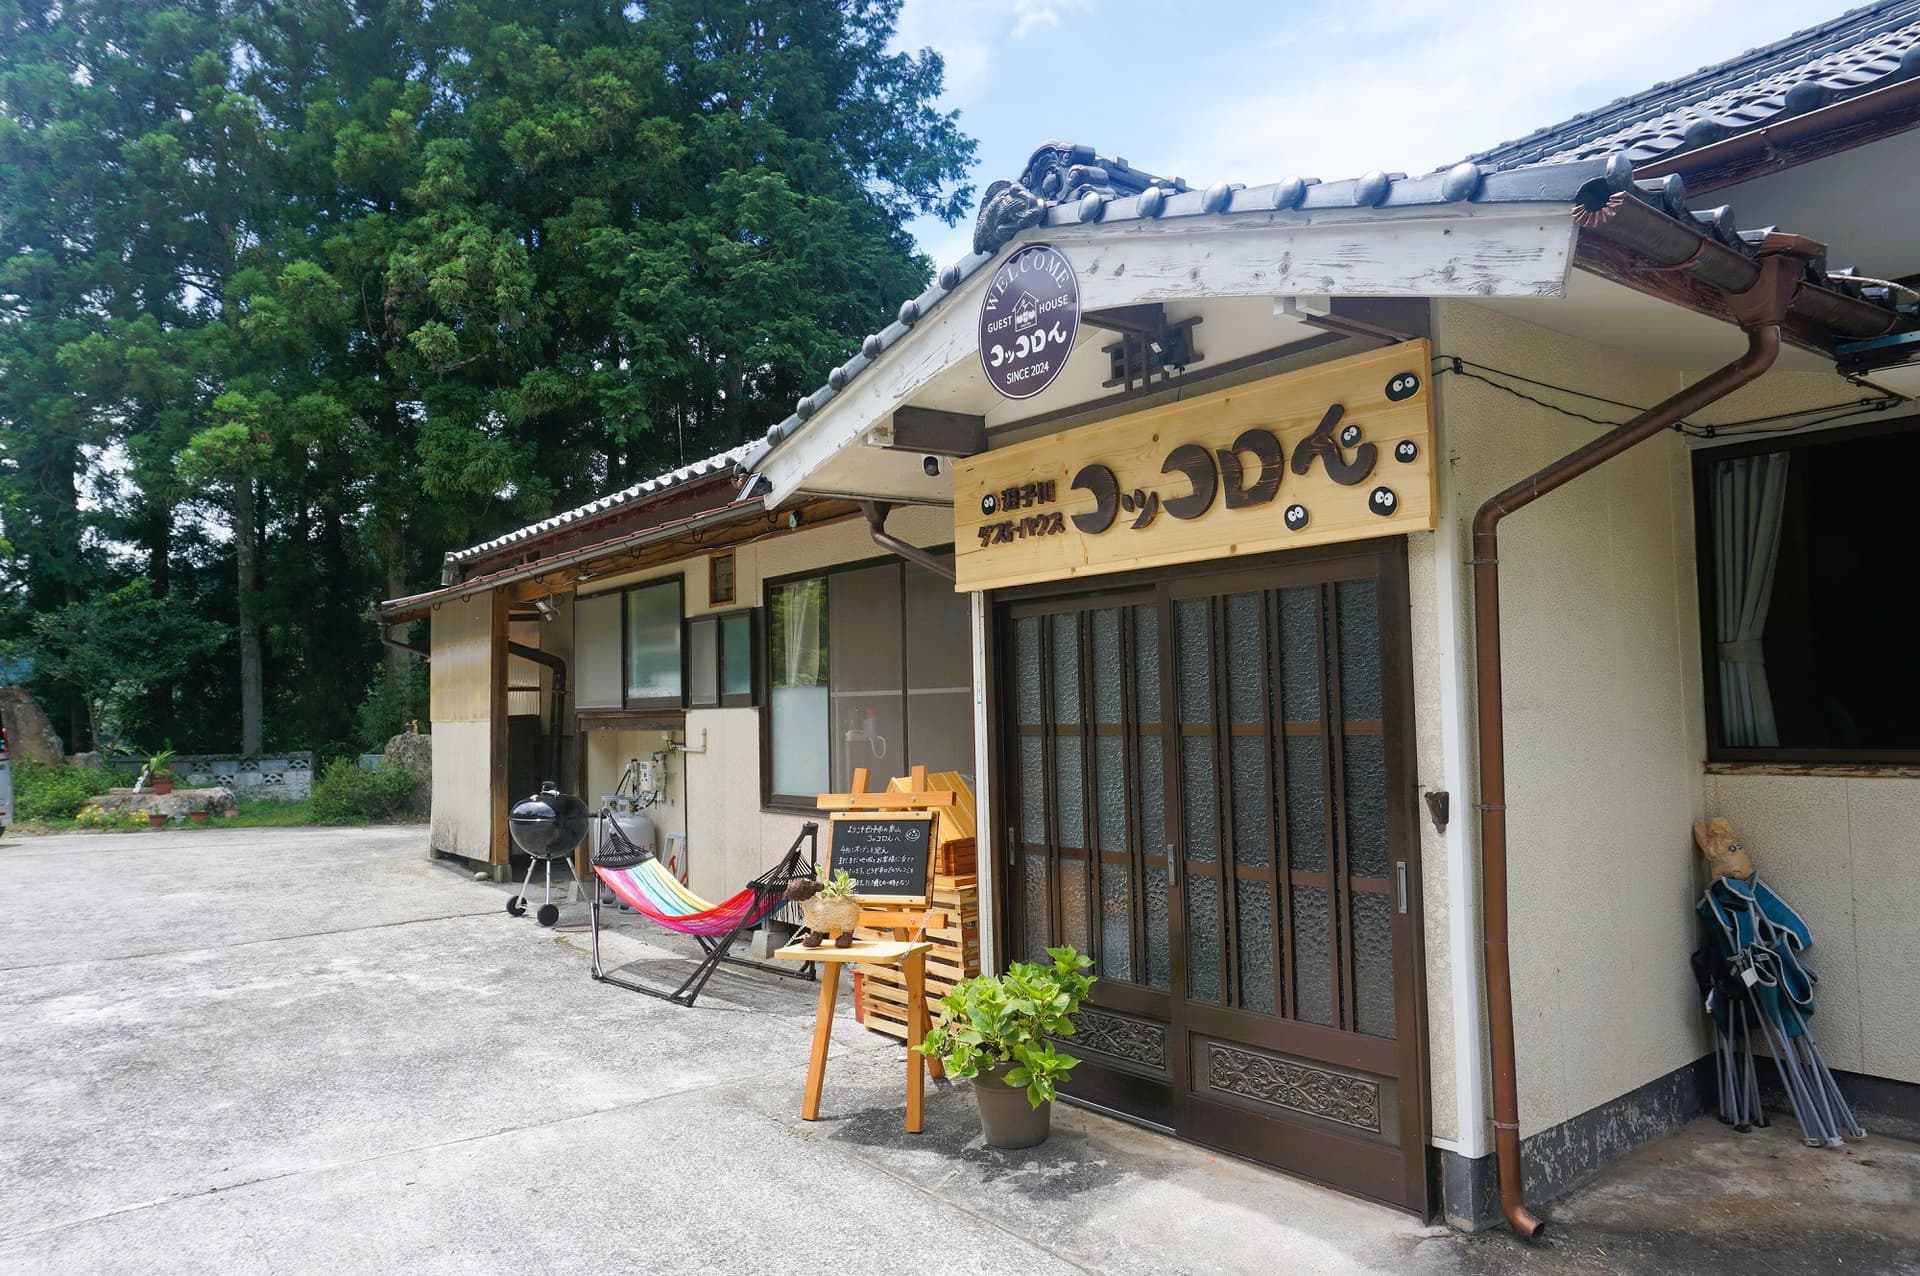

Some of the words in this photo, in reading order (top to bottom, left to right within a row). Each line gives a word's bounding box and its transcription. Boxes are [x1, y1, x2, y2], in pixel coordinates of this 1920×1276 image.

[986, 253, 1069, 311] WELCOME
[987, 315, 1013, 333] GUEST
[1039, 294, 1069, 314] HOUSE
[1006, 367, 1030, 384] SINCE
[1030, 361, 1050, 377] 2024
